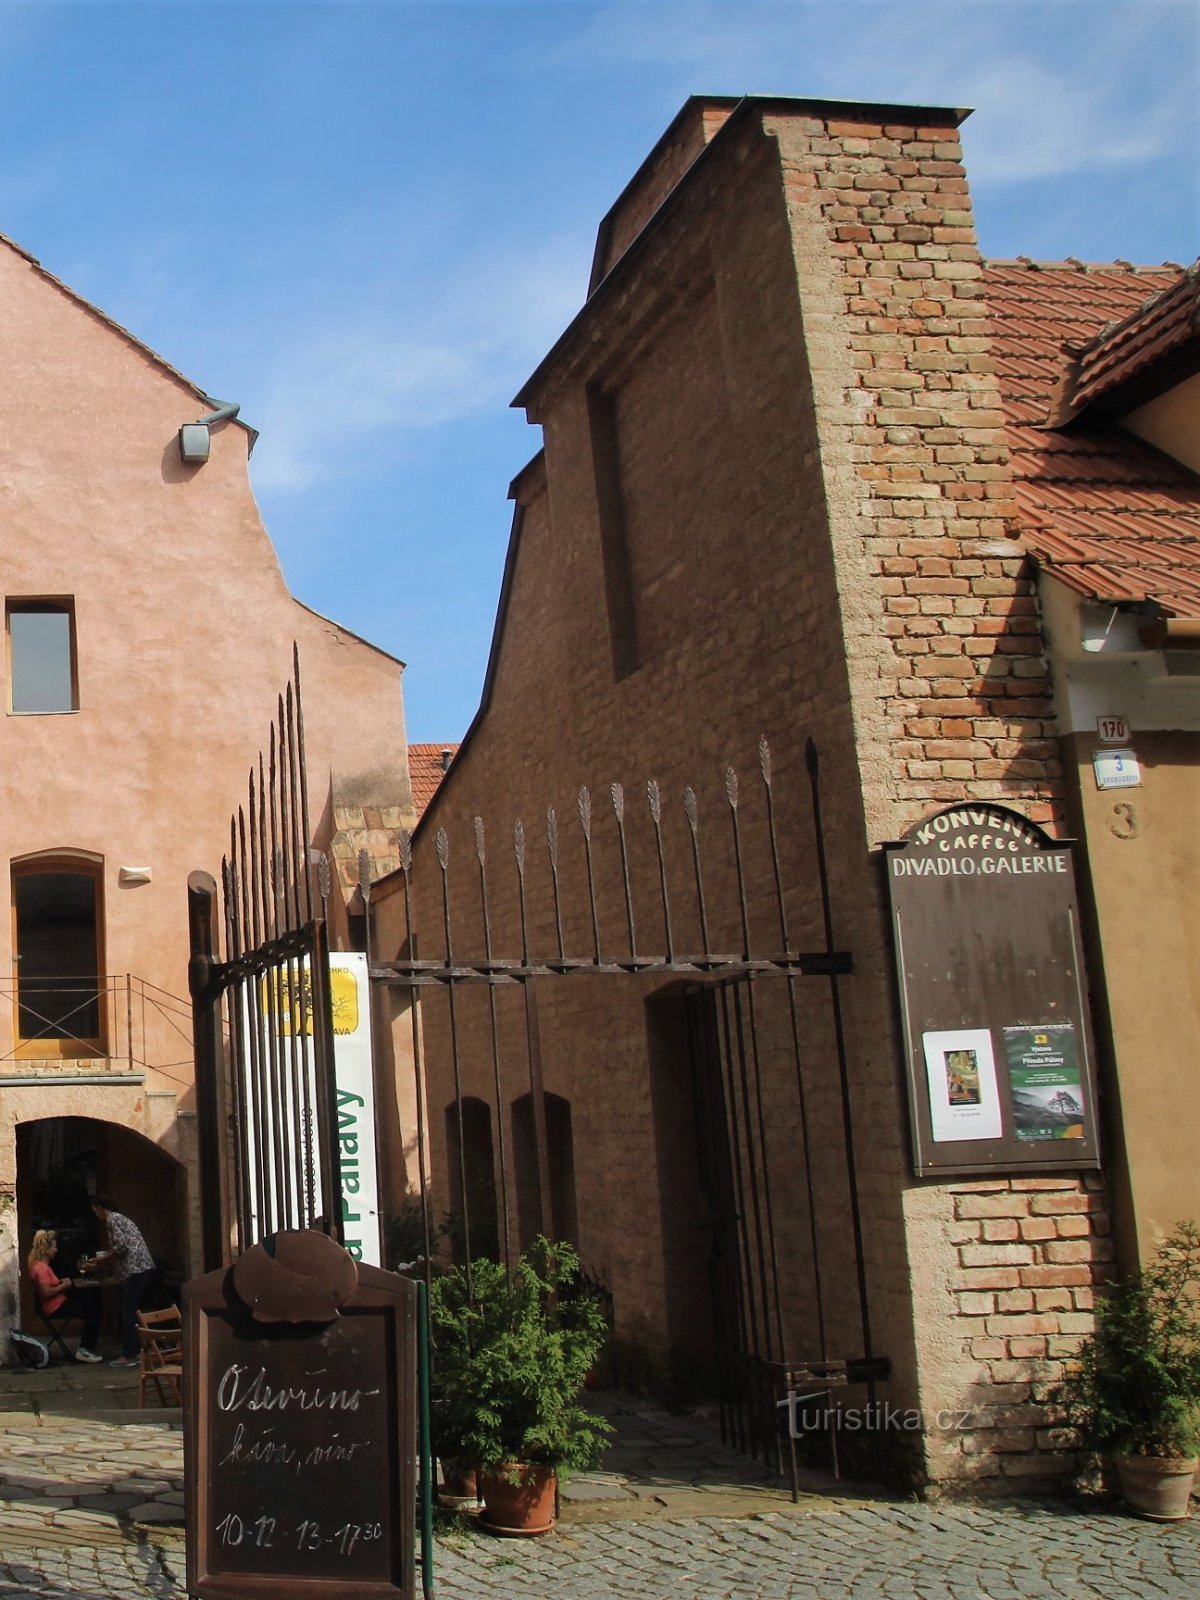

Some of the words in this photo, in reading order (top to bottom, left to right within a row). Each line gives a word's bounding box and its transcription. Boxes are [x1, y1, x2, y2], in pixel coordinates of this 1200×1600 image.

[1102, 721, 1125, 738] 170
[1113, 755, 1124, 772] 3
[1110, 801, 1140, 840] 3
[939, 833, 1019, 852] CAFFEE
[893, 856, 975, 877] DIVADLO
[981, 855, 1068, 874] GALERIE
